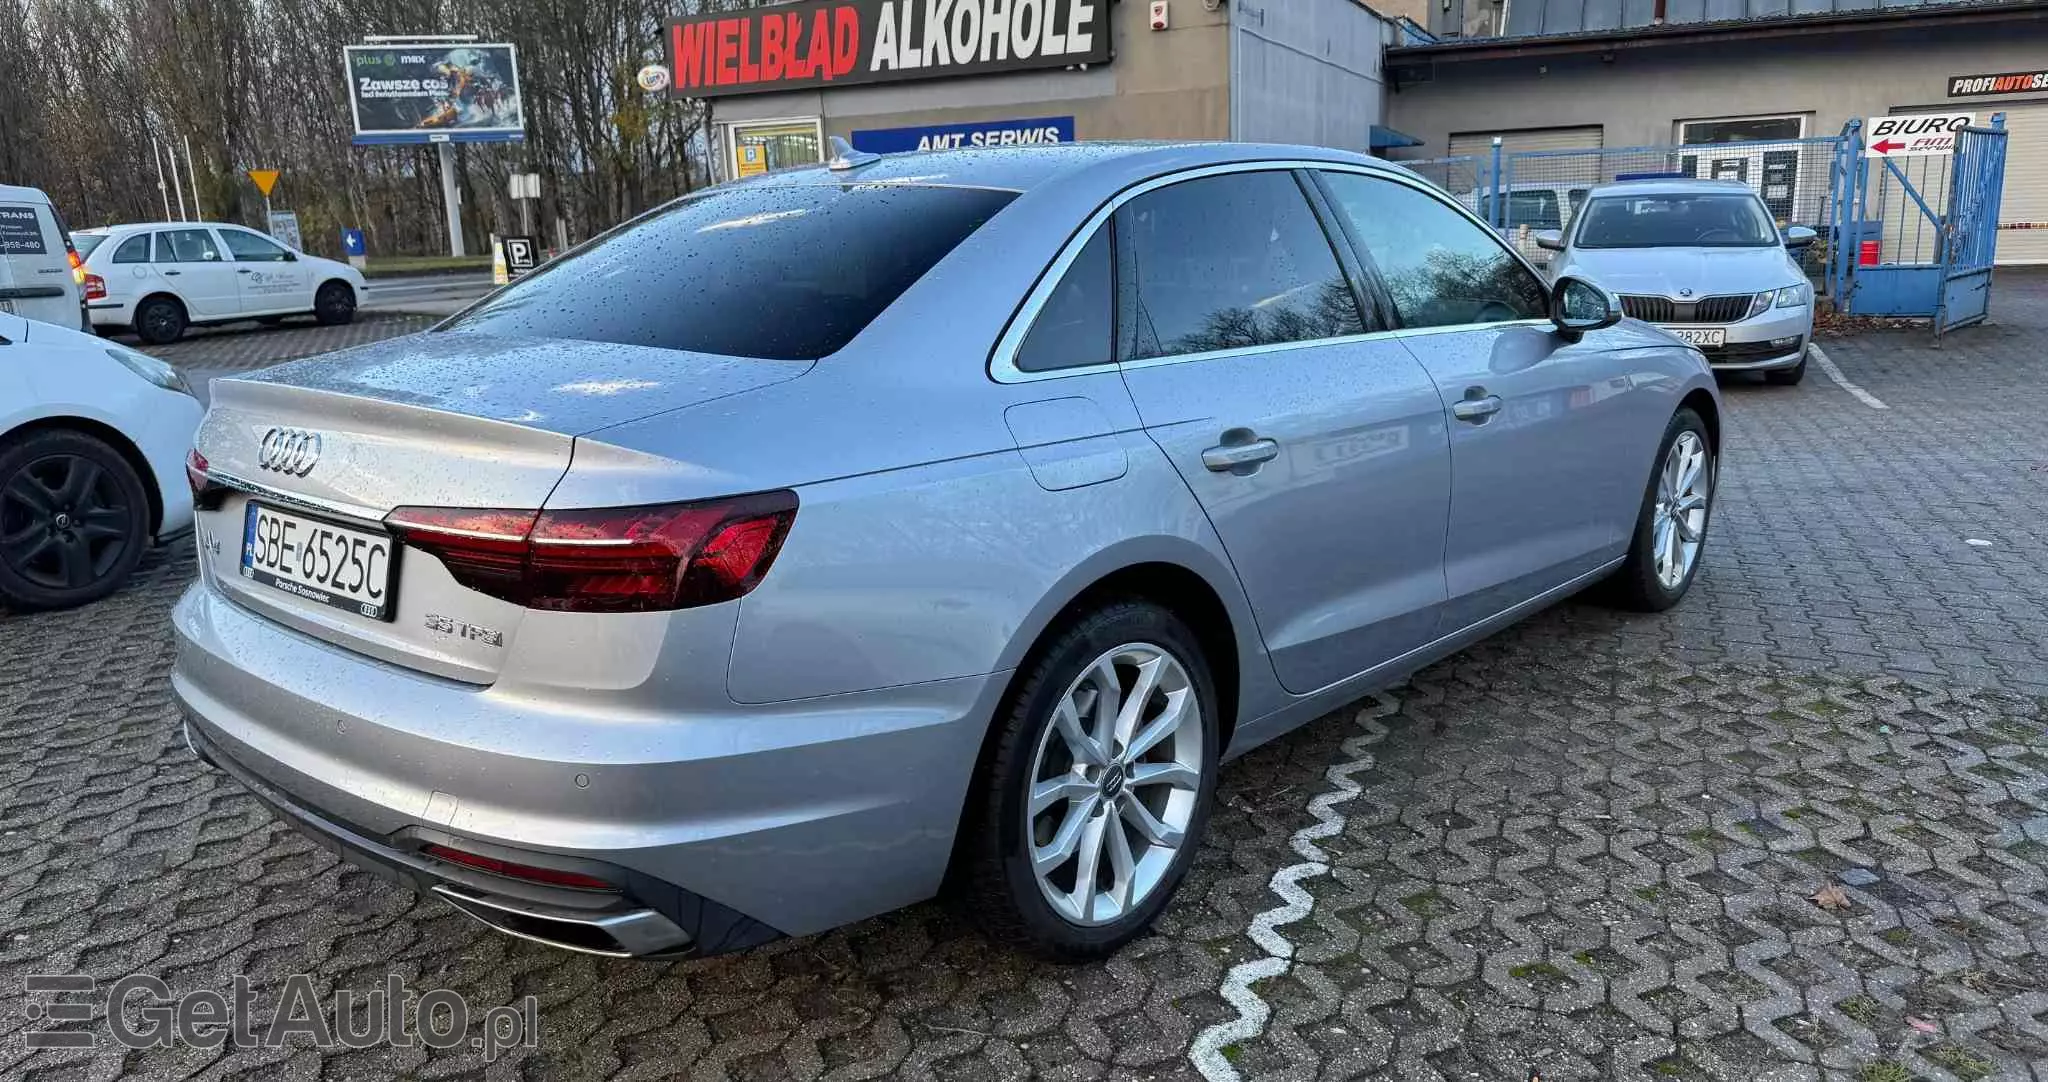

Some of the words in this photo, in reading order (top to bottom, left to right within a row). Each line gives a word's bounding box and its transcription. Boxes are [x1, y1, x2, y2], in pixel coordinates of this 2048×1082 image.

[869, 0, 1093, 72] ALKOHOLE
[355, 55, 381, 67] plus
[401, 55, 426, 64] max
[359, 77, 420, 91] Zawsze
[1872, 116, 1970, 136] BIURO
[917, 132, 965, 151] AMT
[970, 126, 1060, 147] SERWIS
[1907, 144, 1956, 152] serwi
[511, 243, 527, 264] P
[255, 513, 296, 574] SBE
[302, 528, 386, 599] 6525C
[275, 578, 298, 593] Porsche
[297, 585, 330, 603] Sosnowiec
[424, 614, 453, 634] 35
